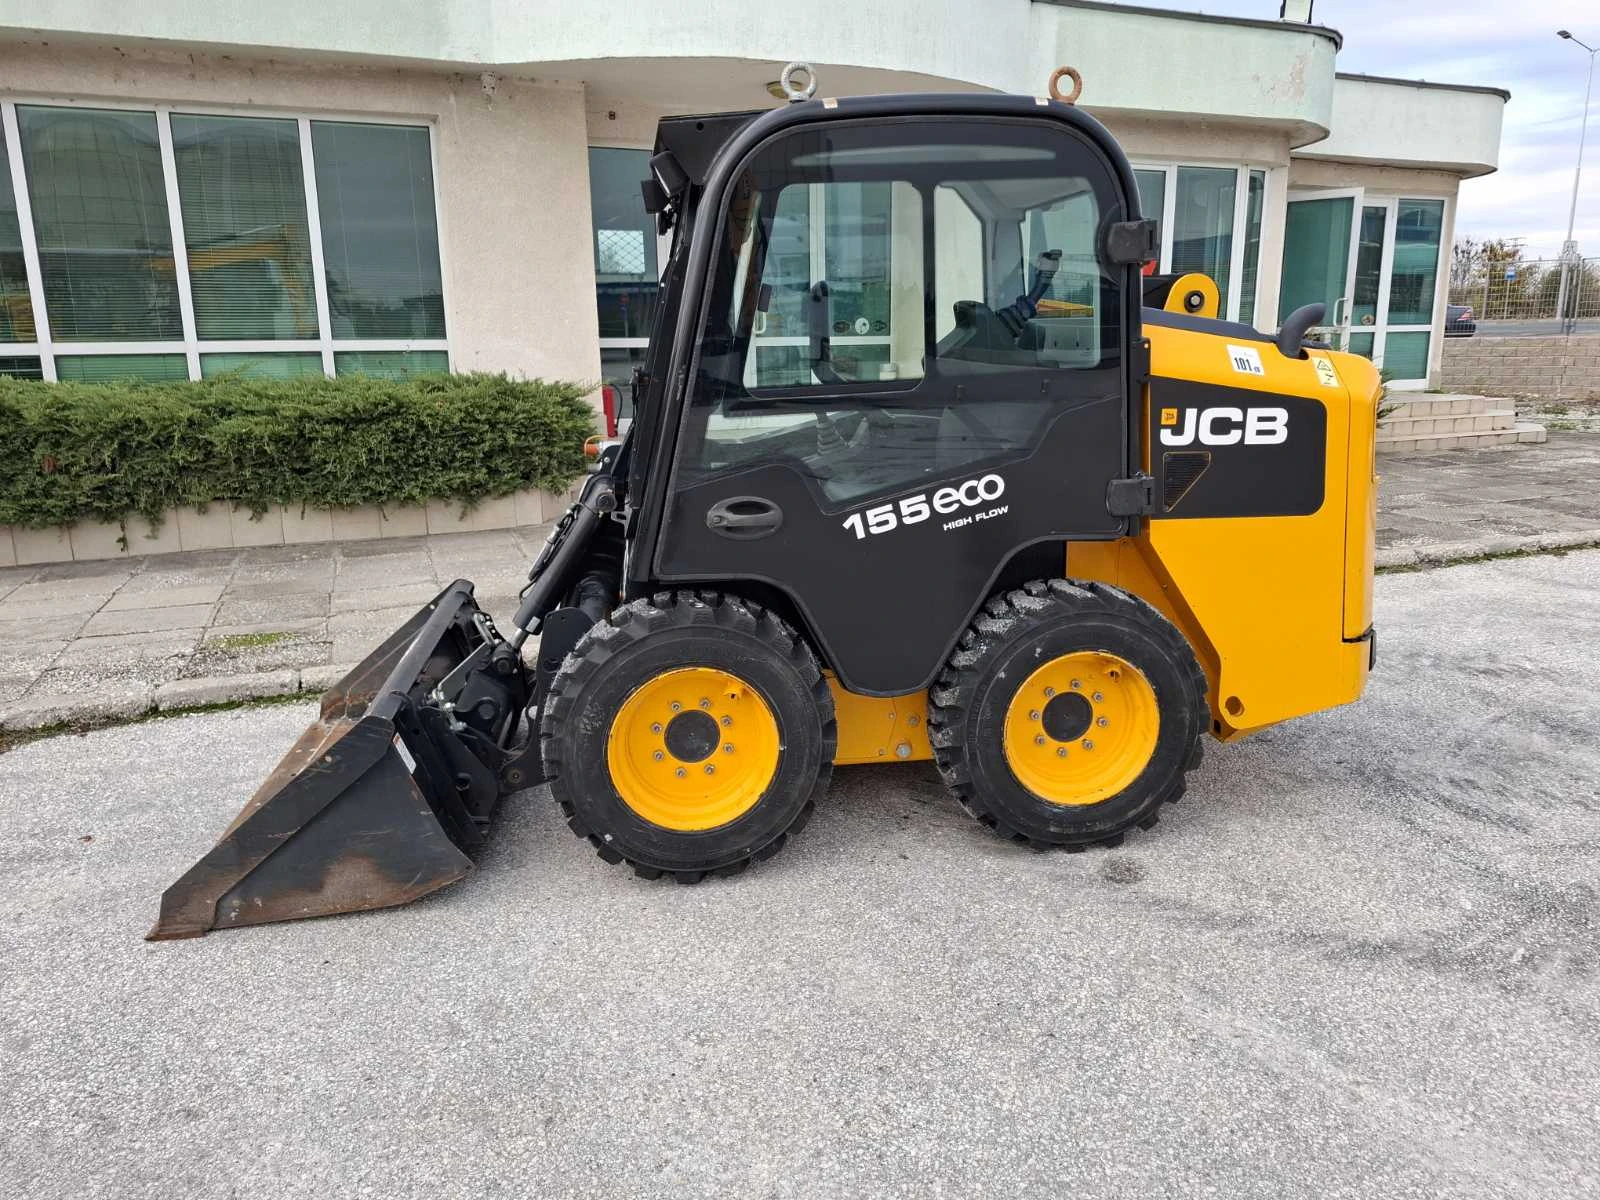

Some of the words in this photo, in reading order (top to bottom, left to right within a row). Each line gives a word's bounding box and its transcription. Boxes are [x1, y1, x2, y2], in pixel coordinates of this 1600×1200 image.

[1234, 357, 1252, 371] 101
[1160, 407, 1288, 446] JCB
[943, 516, 972, 531] HIGH
[975, 505, 1008, 521] FLOW
